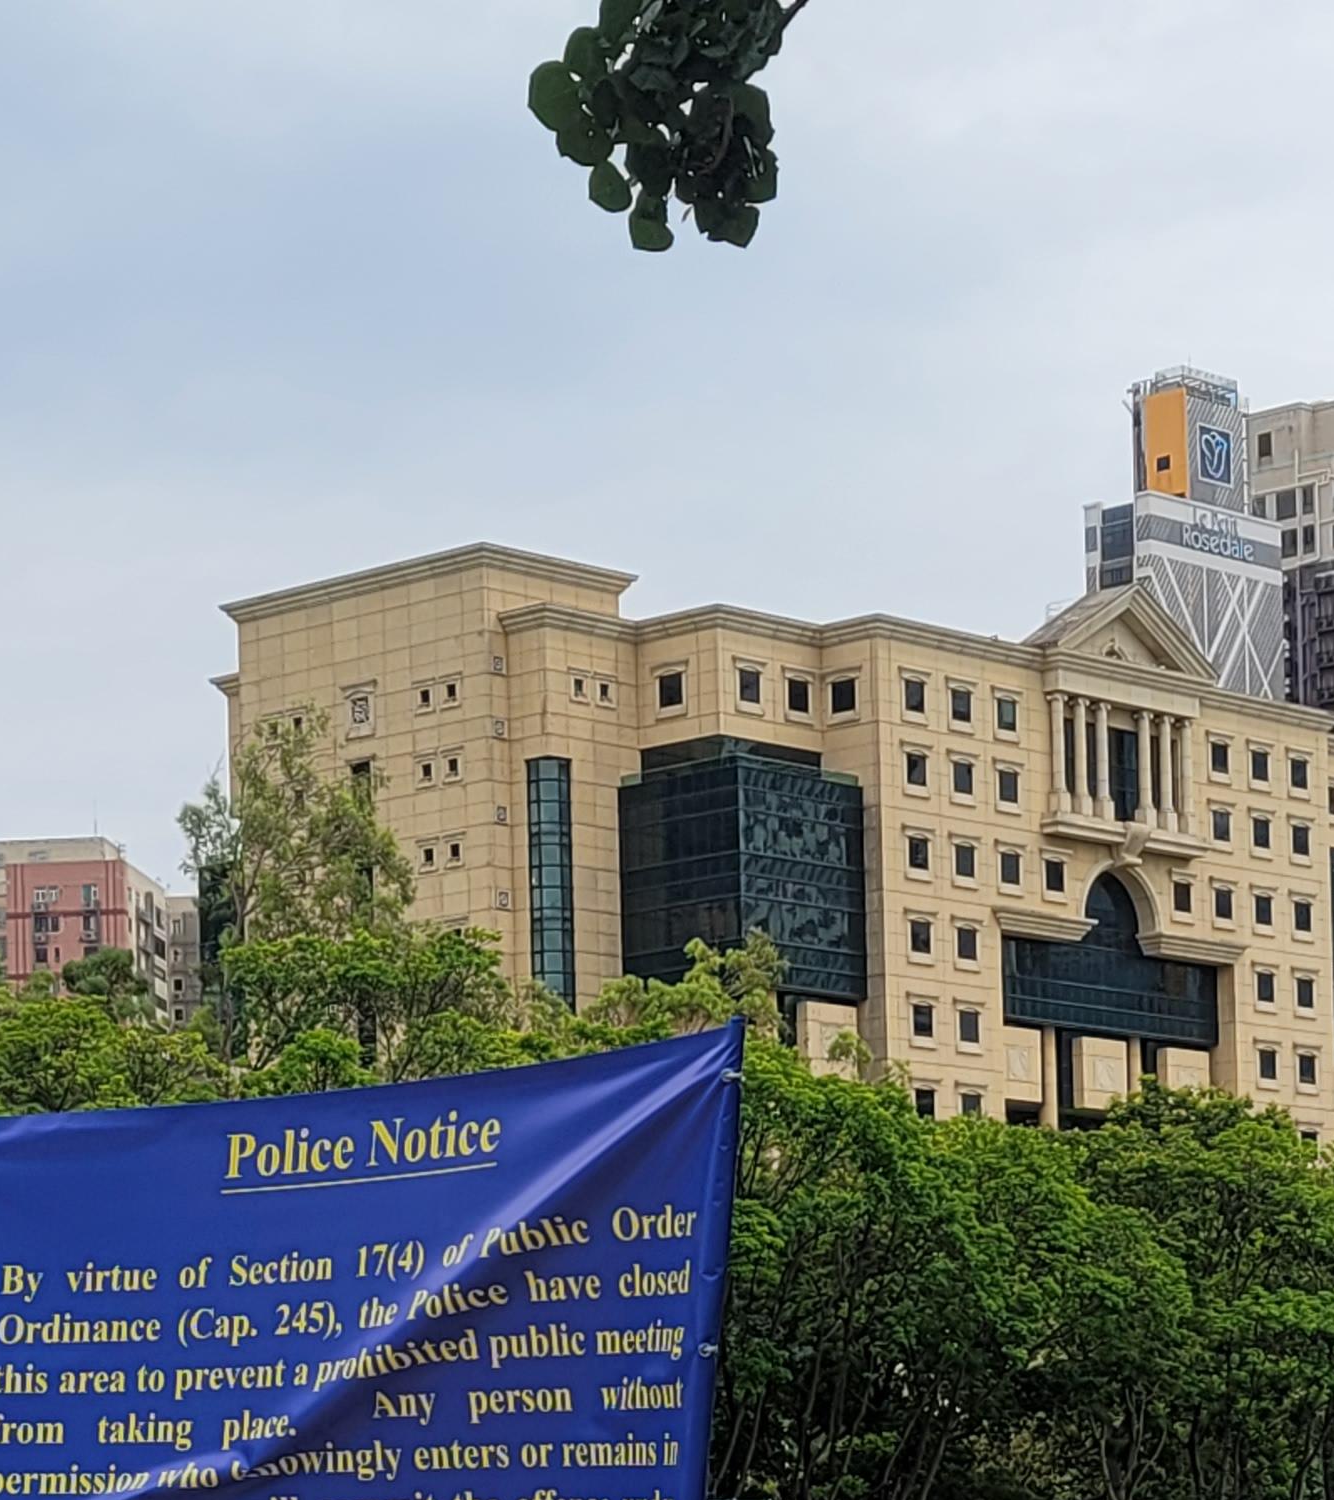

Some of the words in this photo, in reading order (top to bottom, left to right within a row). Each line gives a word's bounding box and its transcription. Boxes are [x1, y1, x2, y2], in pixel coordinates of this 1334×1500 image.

[1182, 524, 1254, 561] Rosedale
[225, 1129, 355, 1179] Police
[369, 1110, 502, 1167] Notice
[0, 1263, 43, 1303] By
[66, 1262, 157, 1293] virtue
[178, 1257, 211, 1288] of
[230, 1252, 333, 1285] Section
[355, 1242, 426, 1280] 17(4)
[442, 1233, 472, 1269] of
[480, 1215, 588, 1258] Public
[611, 1203, 696, 1241] Order
[177, 1308, 257, 1346] (Cap.
[276, 1301, 343, 1337] 245),
[359, 1296, 398, 1330] the
[407, 1283, 509, 1320] Police
[523, 1270, 603, 1302] have
[618, 1260, 692, 1299] closed
[58, 1371, 127, 1394] area
[136, 1367, 166, 1392] to
[174, 1362, 285, 1400] prevent
[293, 1364, 309, 1386] a
[313, 1328, 479, 1391] prohibited
[489, 1318, 586, 1368] public
[596, 1319, 684, 1361] meeting
[97, 1411, 194, 1452] taking
[222, 1409, 297, 1448] place.
[372, 1389, 434, 1425] Any
[467, 1387, 573, 1425] person
[600, 1377, 683, 1410] without
[157, 1462, 219, 1489] who
[412, 1442, 511, 1472] enters
[518, 1442, 554, 1469] or
[561, 1432, 658, 1468] remains
[662, 1432, 679, 1466] in
